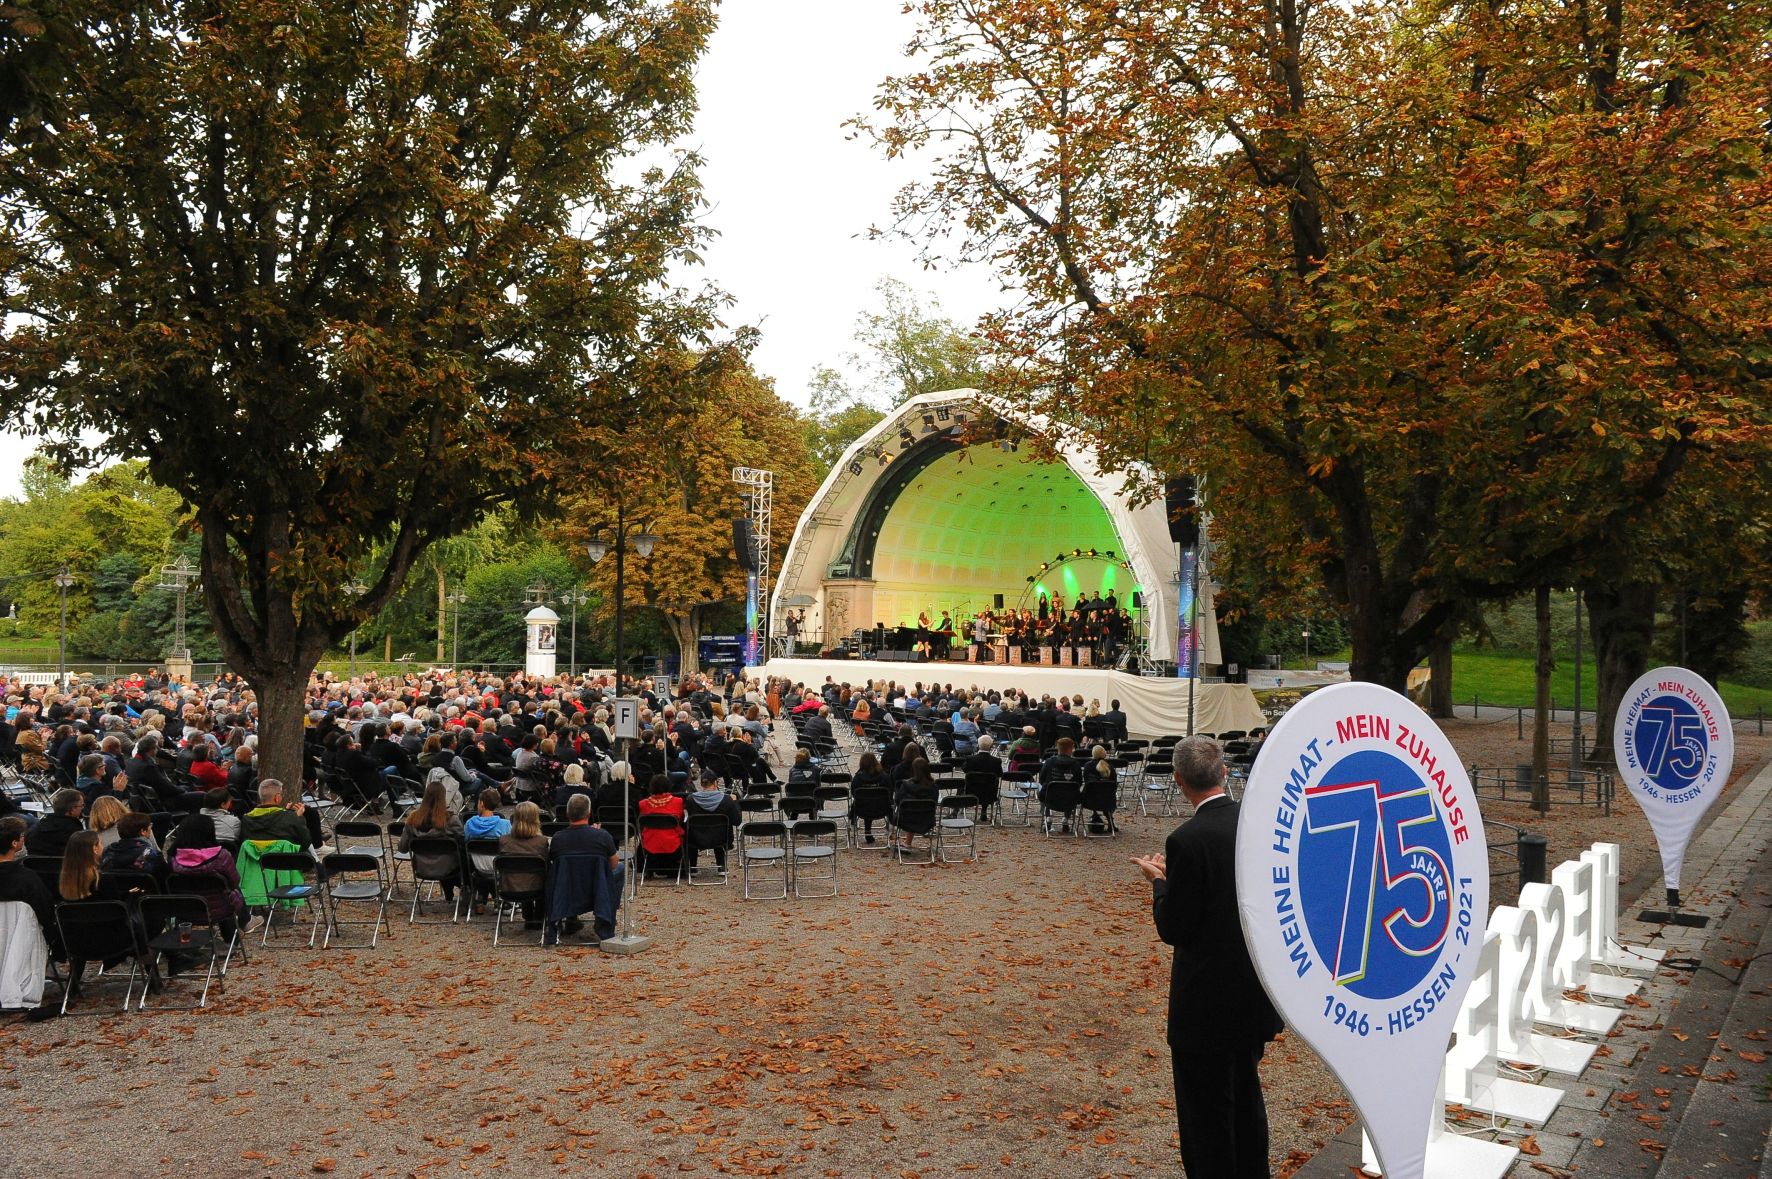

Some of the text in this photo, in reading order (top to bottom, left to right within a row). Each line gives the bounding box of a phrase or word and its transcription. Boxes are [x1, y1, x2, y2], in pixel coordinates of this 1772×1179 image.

[658, 682, 666, 693] B
[1626, 687, 1652, 727] HEIMAT
[1657, 681, 1684, 694] MEIN
[621, 707, 630, 724] F
[1335, 714, 1390, 745] MEIN
[1685, 688, 1719, 742] ZUHAUSE
[1624, 729, 1637, 769] MEINE
[1641, 704, 1707, 780] 75
[1685, 739, 1703, 762] JAHRE
[1273, 737, 1323, 855] HEIMAT
[1395, 724, 1469, 846] ZUHAUSE
[1638, 777, 1658, 799] 1946
[1665, 786, 1702, 804] HESSEN
[1703, 754, 1718, 783] 2021
[1304, 779, 1452, 987] 75
[1410, 853, 1447, 902] JAHRE
[1272, 865, 1313, 978] MEINE
[1324, 995, 1370, 1037] 1946
[1388, 963, 1457, 1036] HESSEN
[1456, 877, 1473, 947] 2021
